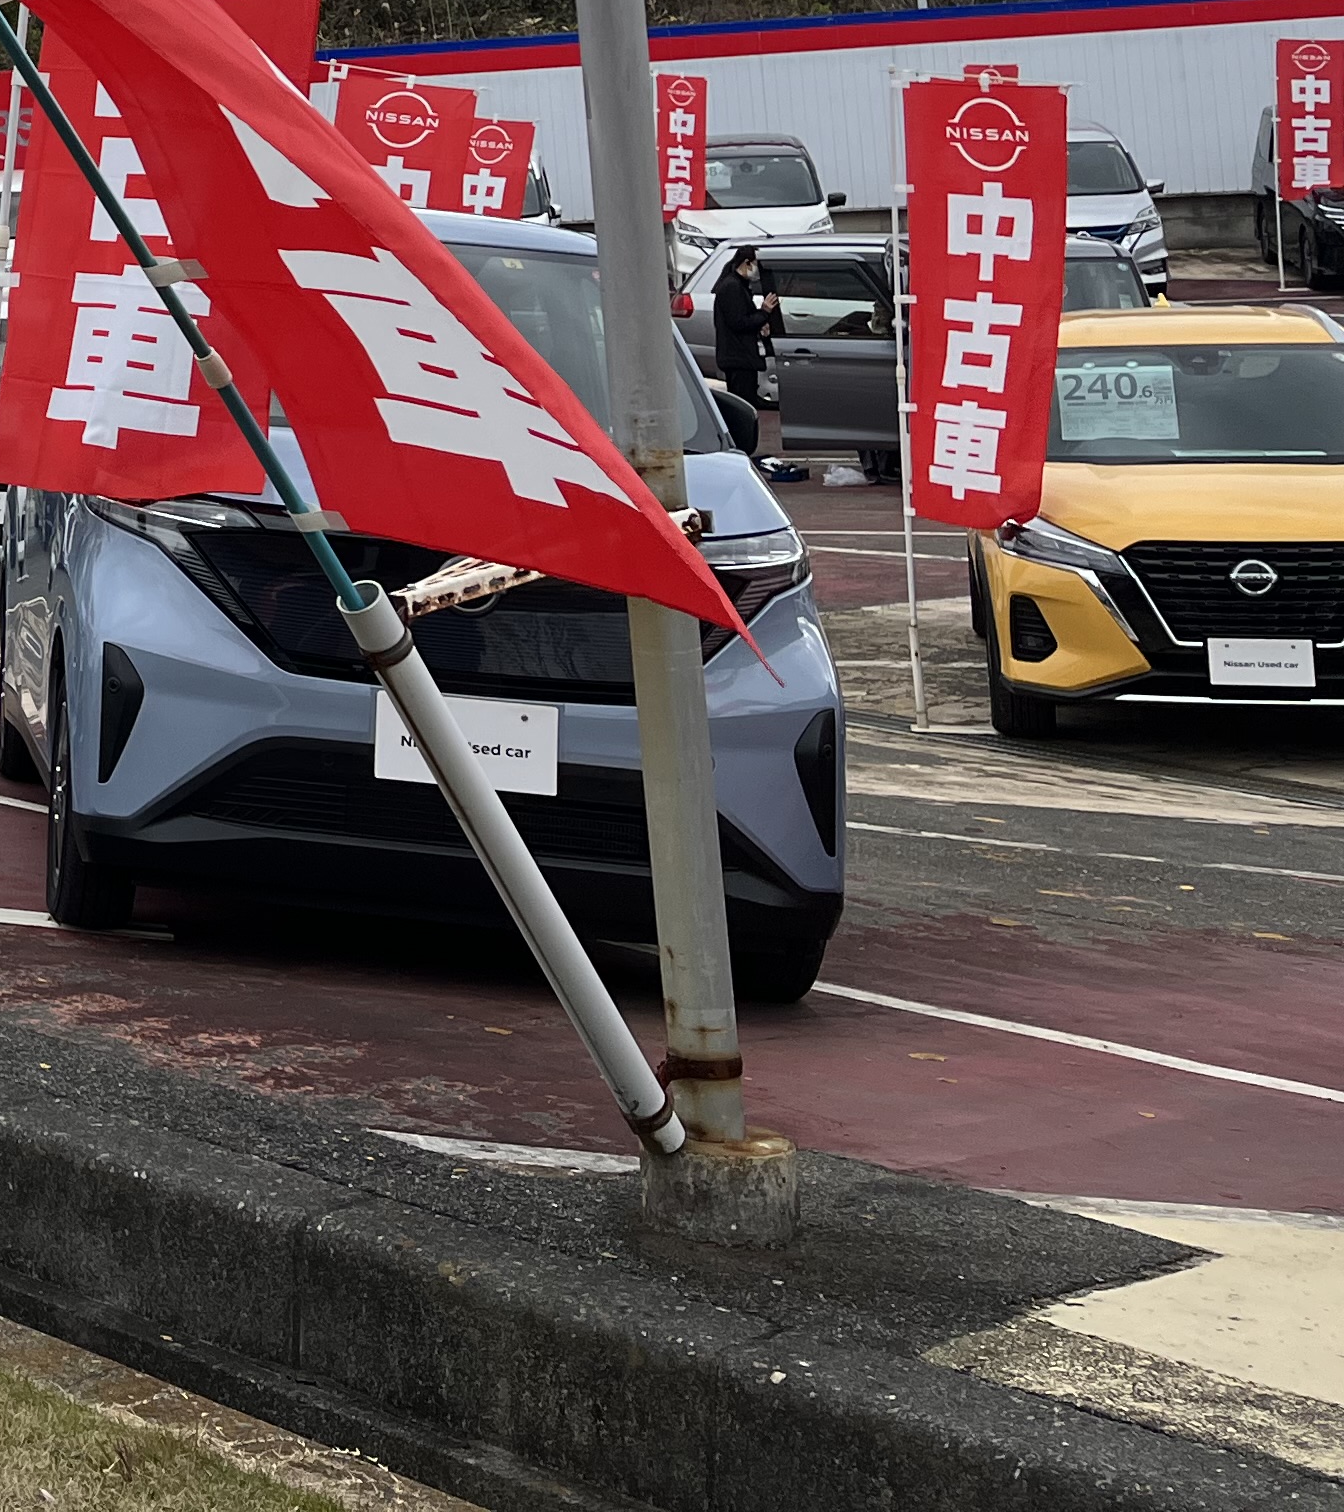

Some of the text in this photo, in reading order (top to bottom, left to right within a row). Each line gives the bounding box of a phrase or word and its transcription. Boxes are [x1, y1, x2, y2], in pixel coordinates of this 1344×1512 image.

[365, 109, 440, 129] NISSAN
[945, 125, 1030, 143] NISSAN
[1290, 73, 1332, 191] 中古車
[928, 180, 1034, 501] 中古車
[1061, 372, 1153, 401] 240.6
[1223, 660, 1256, 668] Nissan
[1257, 661, 1282, 669] Used
[468, 741, 532, 759] sed car
